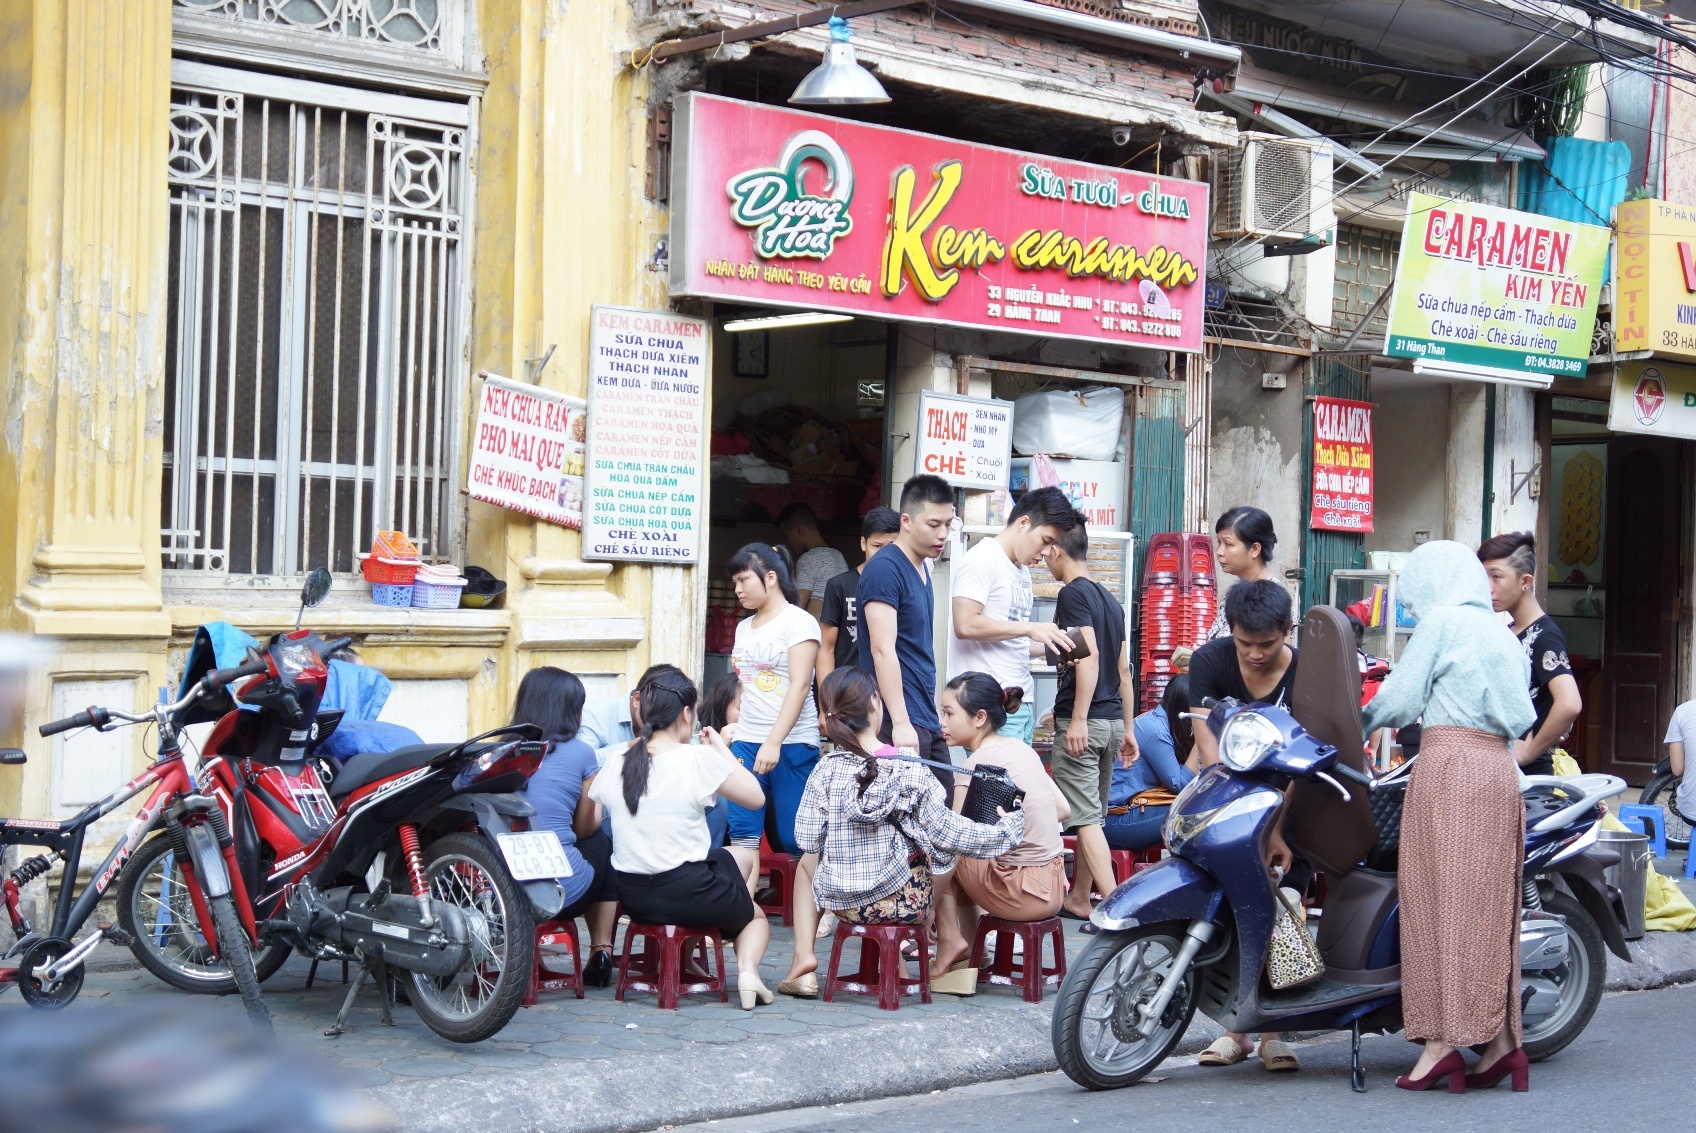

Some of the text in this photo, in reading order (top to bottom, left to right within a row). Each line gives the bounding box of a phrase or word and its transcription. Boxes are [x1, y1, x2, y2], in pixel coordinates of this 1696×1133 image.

[1021, 163, 1067, 200] SỮA
[882, 163, 1198, 303] Kem caramen
[1423, 208, 1573, 275] CARAMEN
[763, 264, 793, 285] HÀNG
[797, 270, 824, 290] THEO
[828, 273, 848, 292] YÊU
[988, 285, 1001, 300] 33
[1073, 296, 1093, 310] NHU
[1504, 272, 1589, 310] KIM YẾN
[987, 303, 1001, 317] 29
[1034, 308, 1061, 324] THAN
[1417, 293, 1439, 311] Sữa
[1441, 296, 1468, 315] chua
[1470, 299, 1492, 322] nếp
[1525, 308, 1555, 330] Thạch
[1557, 313, 1577, 330] dừa
[1624, 287, 1645, 340] TÍN
[599, 313, 702, 338] KEM CARAMEN
[1431, 319, 1453, 337] Chè
[1454, 323, 1478, 341] xoài
[1487, 327, 1508, 344] Chè
[615, 331, 684, 350] SỮA CHUA
[1396, 339, 1446, 356] 31 Hàng Than
[1662, 330, 1679, 347] 33
[599, 346, 699, 365] THẠCH DỪA XIÊM
[609, 361, 649, 375] THẠCH
[1564, 360, 1582, 373] 3469
[597, 375, 618, 387] KEM
[621, 376, 641, 389] DỪA
[673, 381, 699, 395] NƯỚC
[596, 389, 642, 402] CARAMEN
[484, 386, 571, 434] NEM CHUA RÁN
[602, 403, 693, 421] CARAMEN THẠCH
[596, 416, 648, 429] CARAMEN
[651, 421, 673, 432] HOA
[927, 407, 969, 446] THẠCH
[976, 409, 988, 420] SEN
[974, 424, 987, 435] NHO
[1316, 402, 1371, 445] CARAMEN
[478, 422, 565, 471] PHO MAI QUE
[596, 431, 649, 444] CARAMEN
[595, 445, 648, 458] CARAMEN
[1315, 442, 1335, 470] Thạch
[595, 458, 614, 470] SỮA
[617, 461, 642, 472] CHUA
[924, 450, 966, 476] CHÈ
[474, 463, 557, 502] CHÈ KHÚC BẠCH
[609, 473, 630, 483] HOA
[976, 470, 996, 481] Xoài
[593, 486, 614, 498] SỮA
[618, 489, 645, 500] CHUA
[594, 500, 615, 512] SỮA
[619, 503, 646, 514] CHUA
[670, 505, 692, 517] DỪA
[1314, 494, 1331, 508] Chè
[1348, 496, 1371, 515] riêng
[593, 514, 615, 526] SỮA
[618, 517, 645, 528] CHUA
[647, 519, 667, 529] HOA
[1324, 512, 1361, 528] Chè xoài
[608, 527, 677, 542] CHÈ XOÀI
[594, 542, 619, 554] CHÈ
[651, 544, 690, 557] RIÊNG
[274, 850, 306, 871] HONDA
